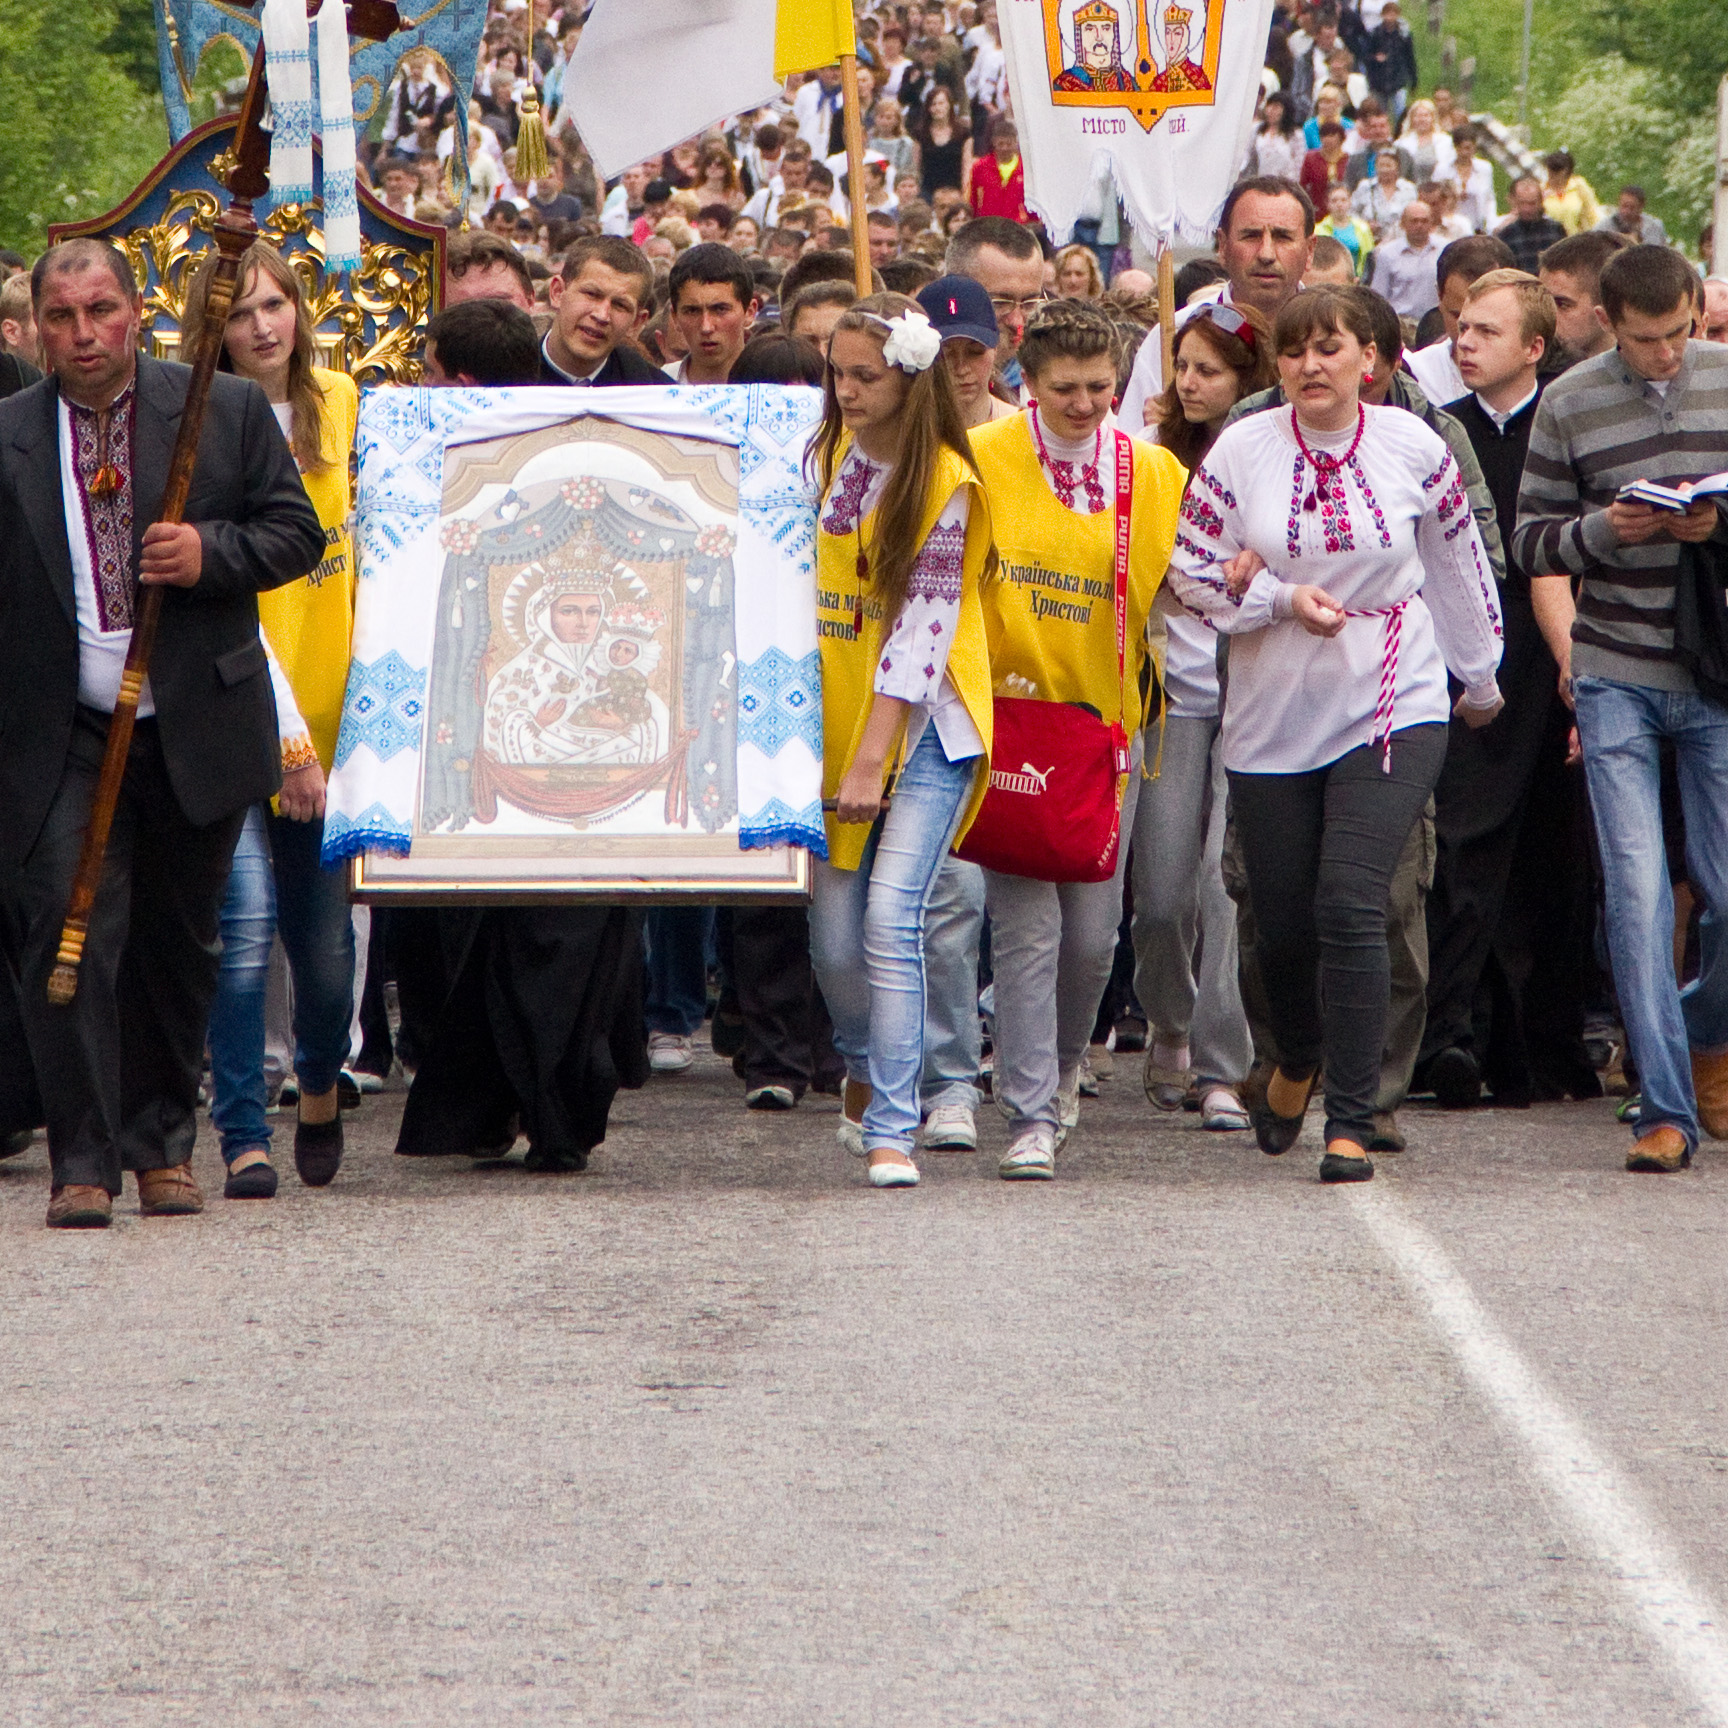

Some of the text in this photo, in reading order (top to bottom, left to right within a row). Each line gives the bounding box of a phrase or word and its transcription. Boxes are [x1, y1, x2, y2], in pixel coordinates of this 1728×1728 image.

[1082, 116, 1126, 135] МІСТО
[1117, 439, 1130, 495] PUMA
[1117, 515, 1129, 574] PUMA
[999, 558, 1115, 601] Українська моло
[1029, 589, 1094, 624] Христові
